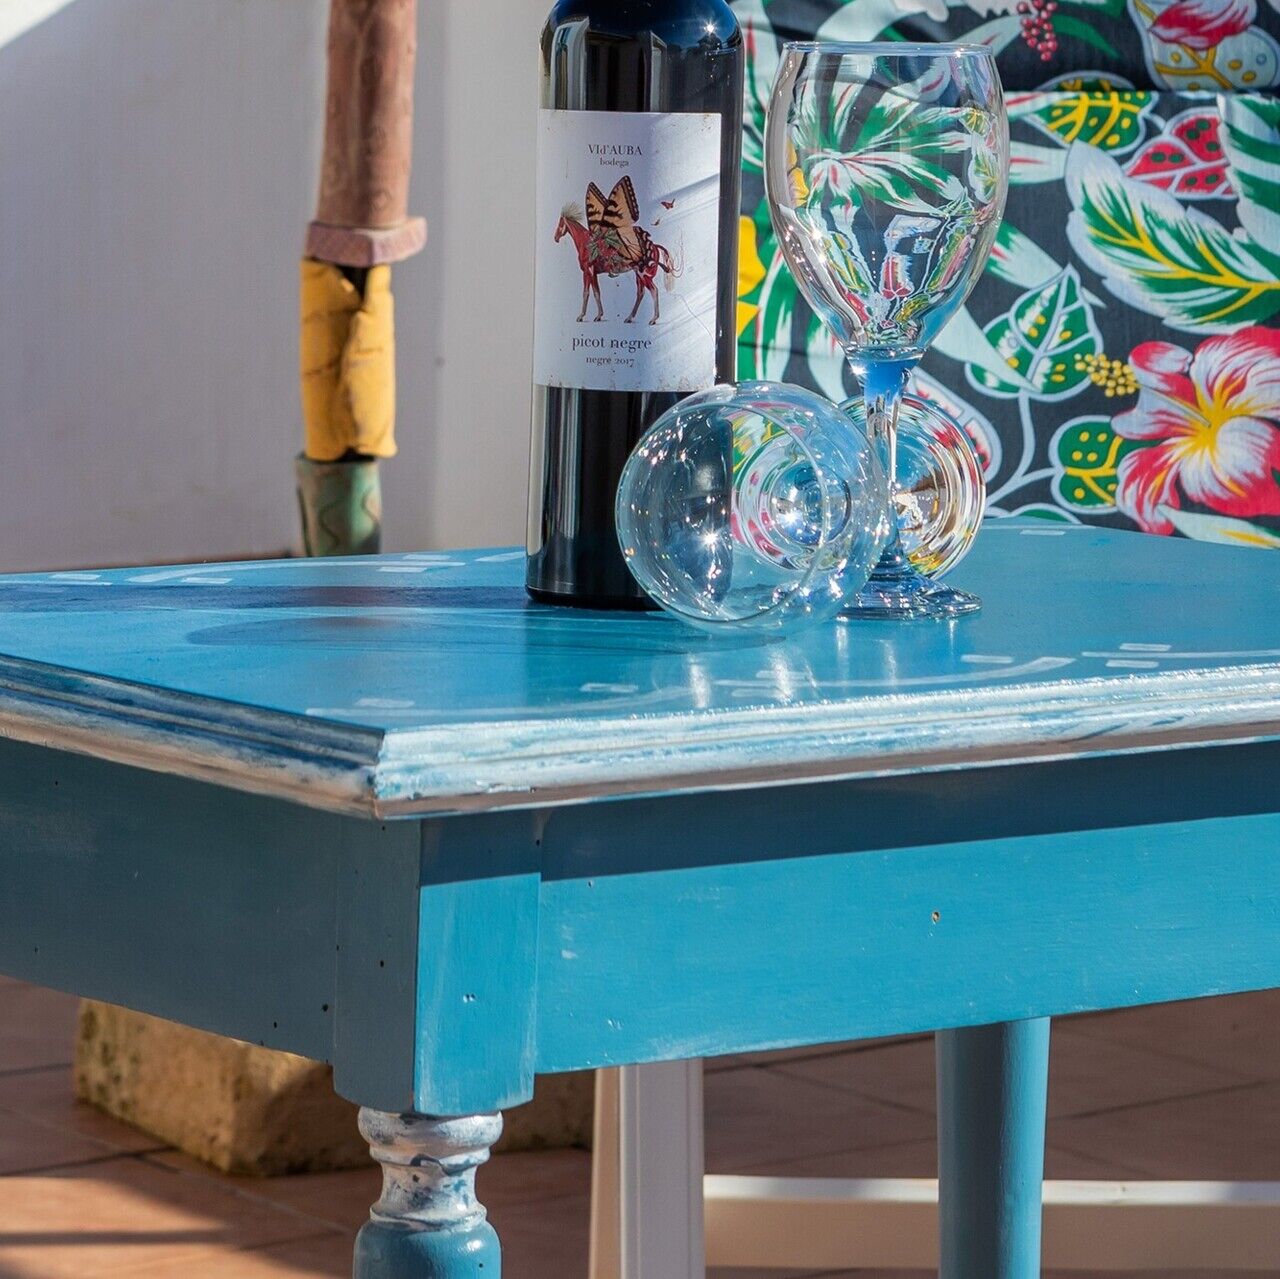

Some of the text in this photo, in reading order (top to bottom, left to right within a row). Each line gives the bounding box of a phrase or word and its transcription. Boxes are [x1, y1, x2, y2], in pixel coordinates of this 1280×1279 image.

[599, 157, 629, 168] bodega
[572, 334, 652, 353] picot negre
[586, 356, 635, 368] negre 2017
